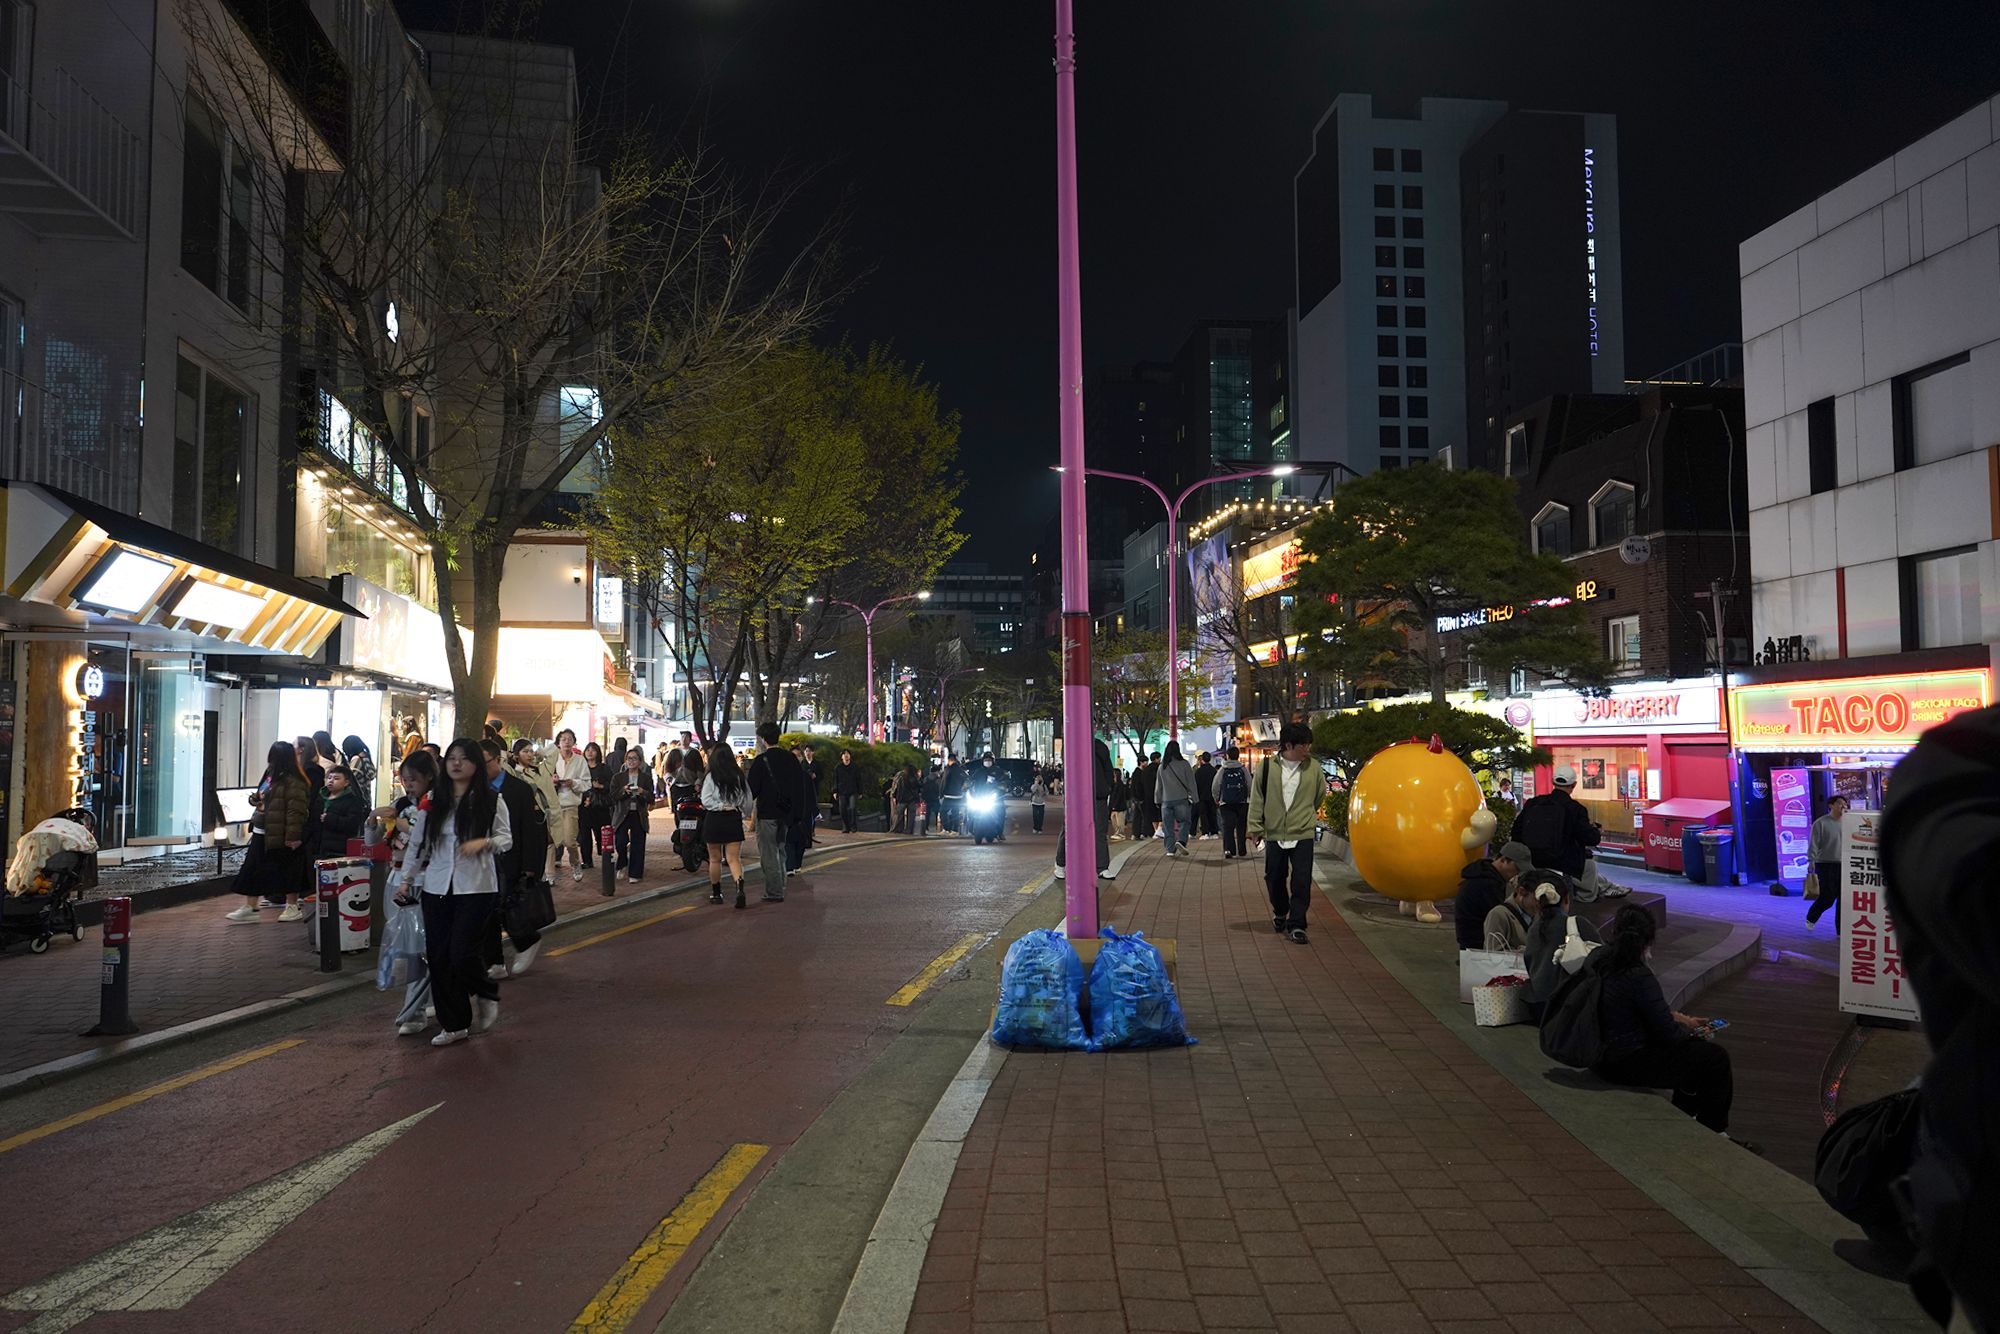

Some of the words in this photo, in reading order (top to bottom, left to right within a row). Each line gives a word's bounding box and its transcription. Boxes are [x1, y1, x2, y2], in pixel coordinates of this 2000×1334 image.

[1576, 580, 1597, 601] 테오
[1487, 605, 1514, 623] THEO
[1588, 694, 1680, 719] BURGERRY
[1911, 698, 1951, 710] MEXICAN
[1952, 697, 1979, 708] TACO
[1789, 692, 1908, 736] TACO
[1911, 711, 1946, 723] DRINKS
[1741, 721, 1790, 736] Whatever
[1851, 890, 1877, 985] 버스킹존
